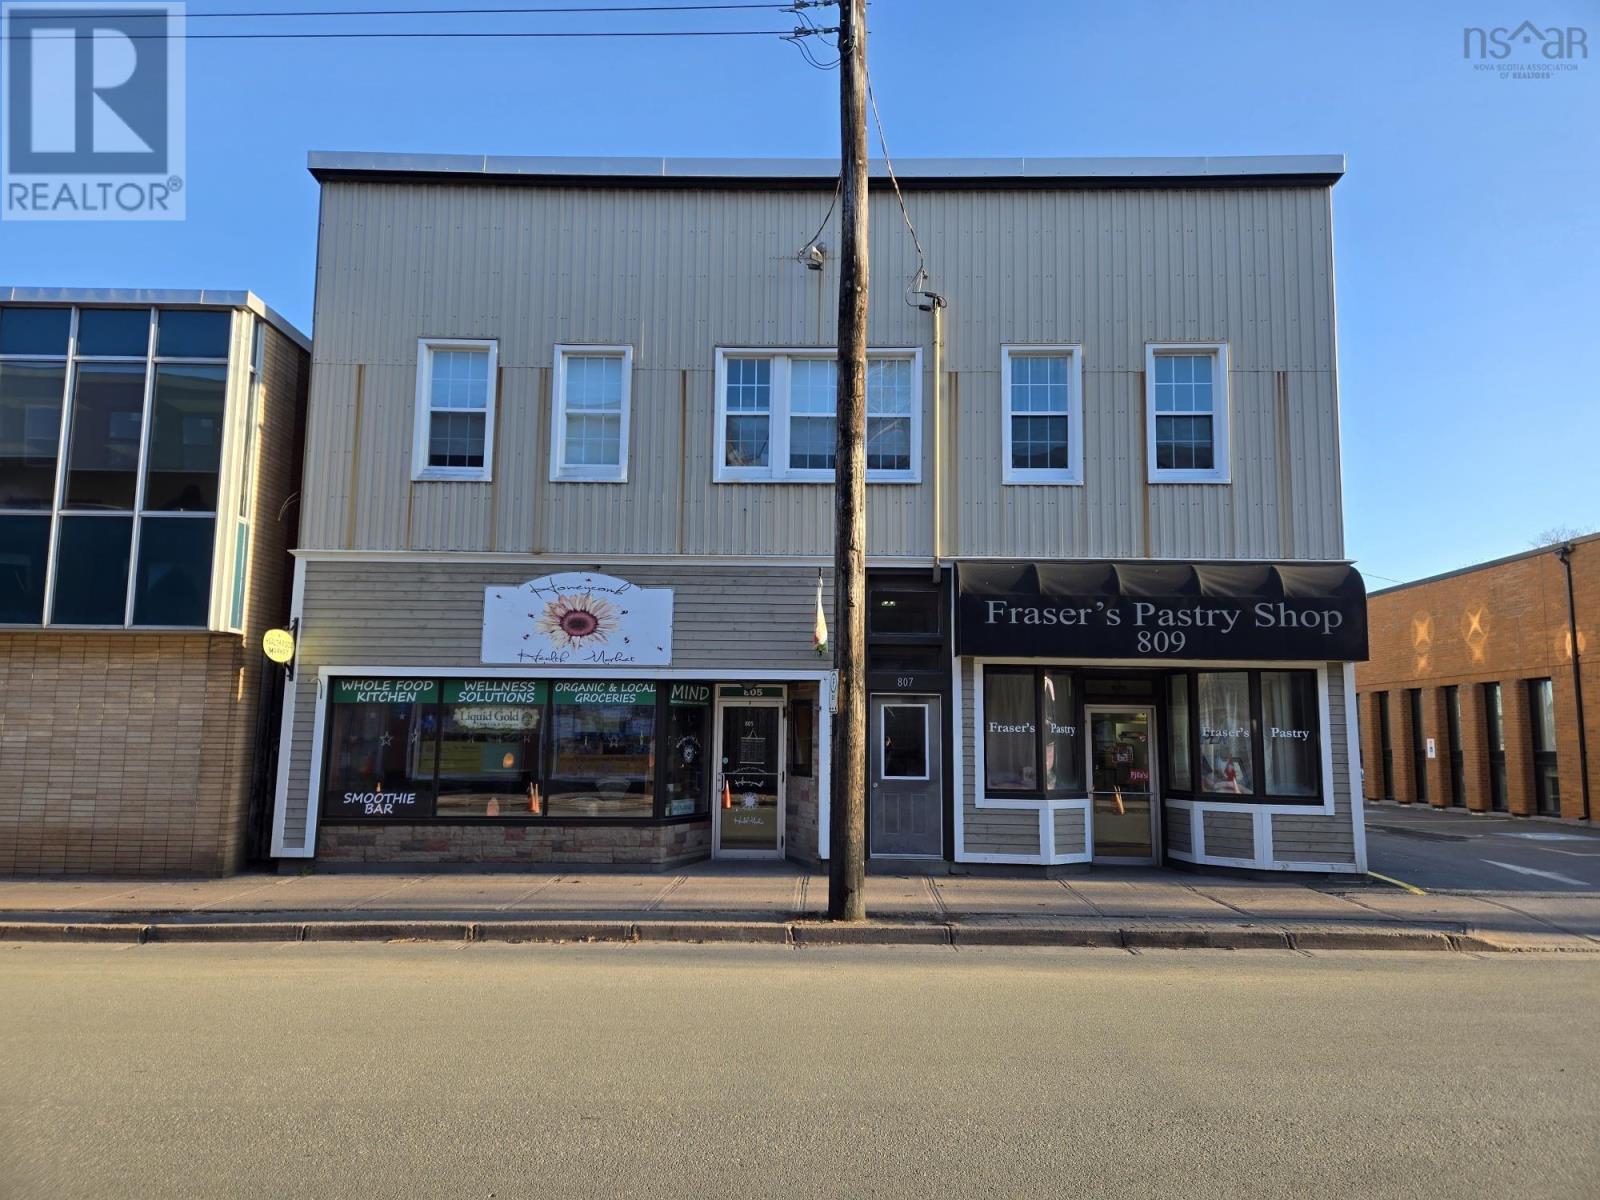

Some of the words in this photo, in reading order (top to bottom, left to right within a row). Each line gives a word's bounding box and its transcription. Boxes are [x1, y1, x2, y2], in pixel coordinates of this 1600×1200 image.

[985, 600, 1121, 625] Fraser's
[1133, 602, 1242, 633] Pastry
[1254, 602, 1343, 635] Shop
[1137, 631, 1186, 653] 809
[341, 680, 390, 691] WHOLE
[395, 680, 434, 691] FOOD
[464, 681, 536, 691] WELLNESS
[555, 682, 604, 693] ORGANIC
[608, 683, 617, 692] &
[621, 683, 657, 693] LOCAL
[897, 677, 914, 687] 807
[356, 691, 417, 703] KITCHEN
[457, 691, 535, 703] SOLUTIONS
[574, 693, 636, 704] GROCERIES
[671, 684, 710, 701] MIND
[460, 711, 492, 724] Liquid
[494, 711, 519, 721] Gold
[989, 722, 1036, 733] Fraser's
[1050, 722, 1077, 736] Pastry
[1201, 726, 1250, 737] Fraser's
[1271, 727, 1310, 741] Pastry
[343, 792, 416, 804] SMOOTHIE
[364, 803, 393, 815] BAR
